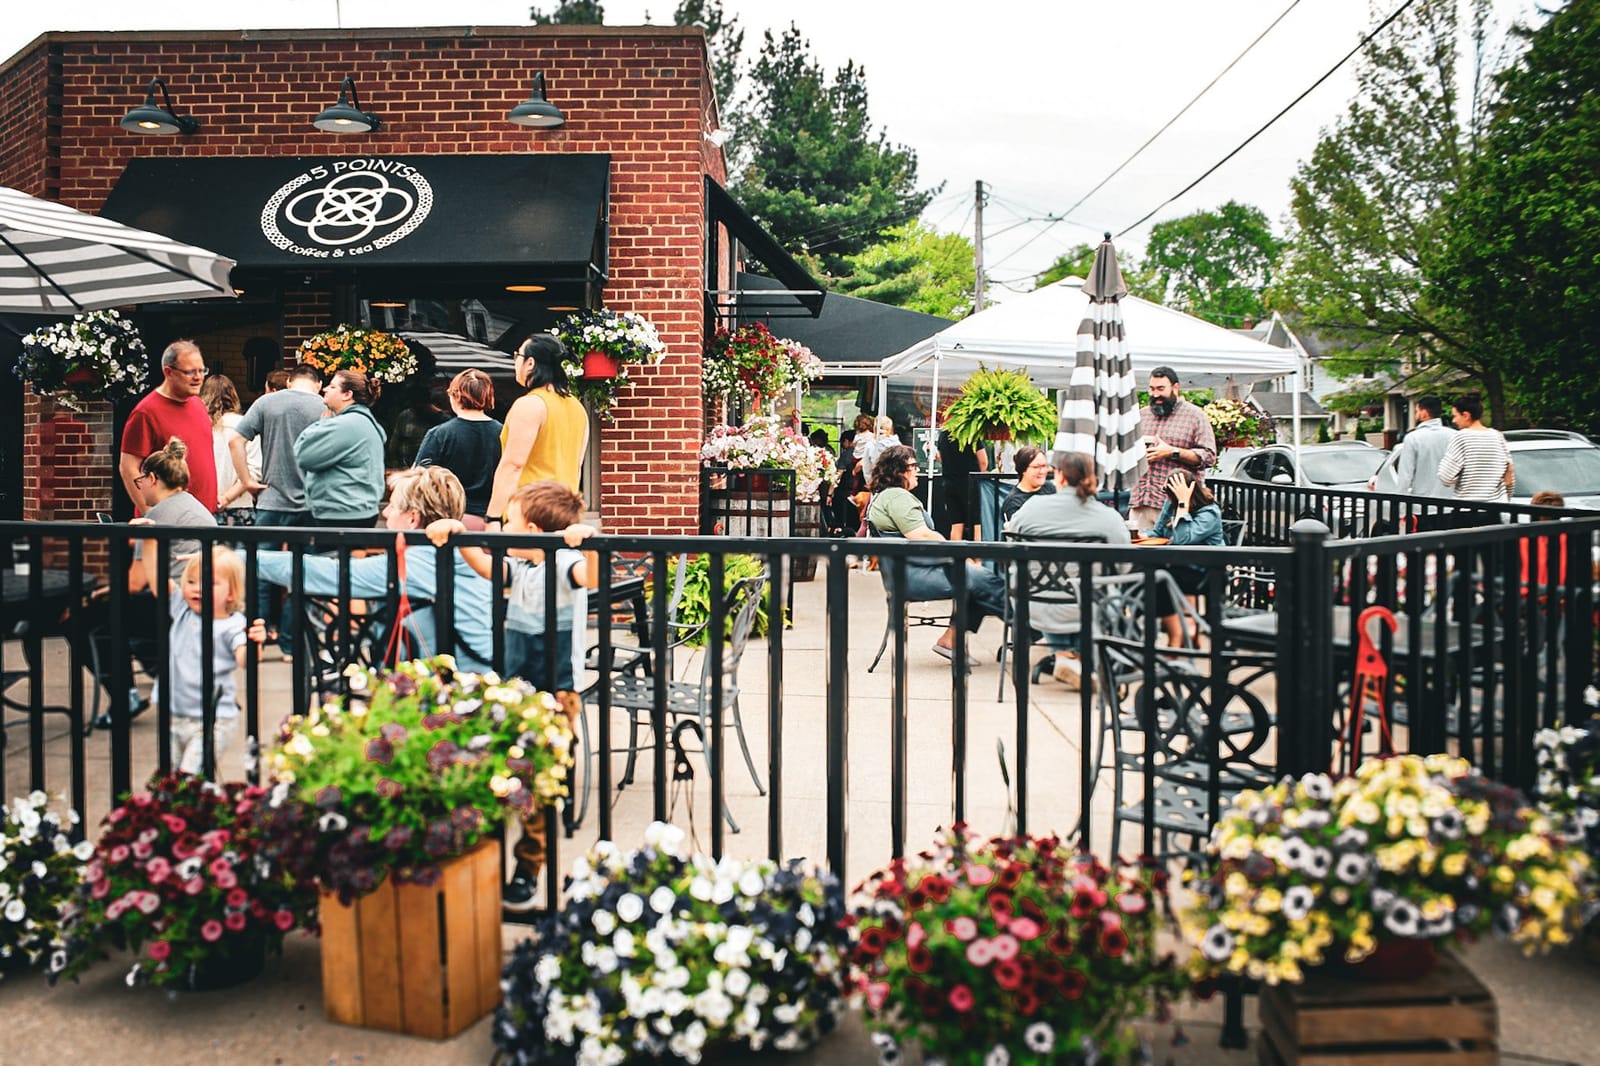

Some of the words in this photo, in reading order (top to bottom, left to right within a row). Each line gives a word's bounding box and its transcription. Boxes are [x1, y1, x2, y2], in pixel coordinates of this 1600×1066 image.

[310, 165, 328, 180] 5
[332, 159, 417, 178] POINTS
[289, 244, 330, 258] coffee
[332, 248, 345, 258] &
[348, 244, 373, 256] tea
